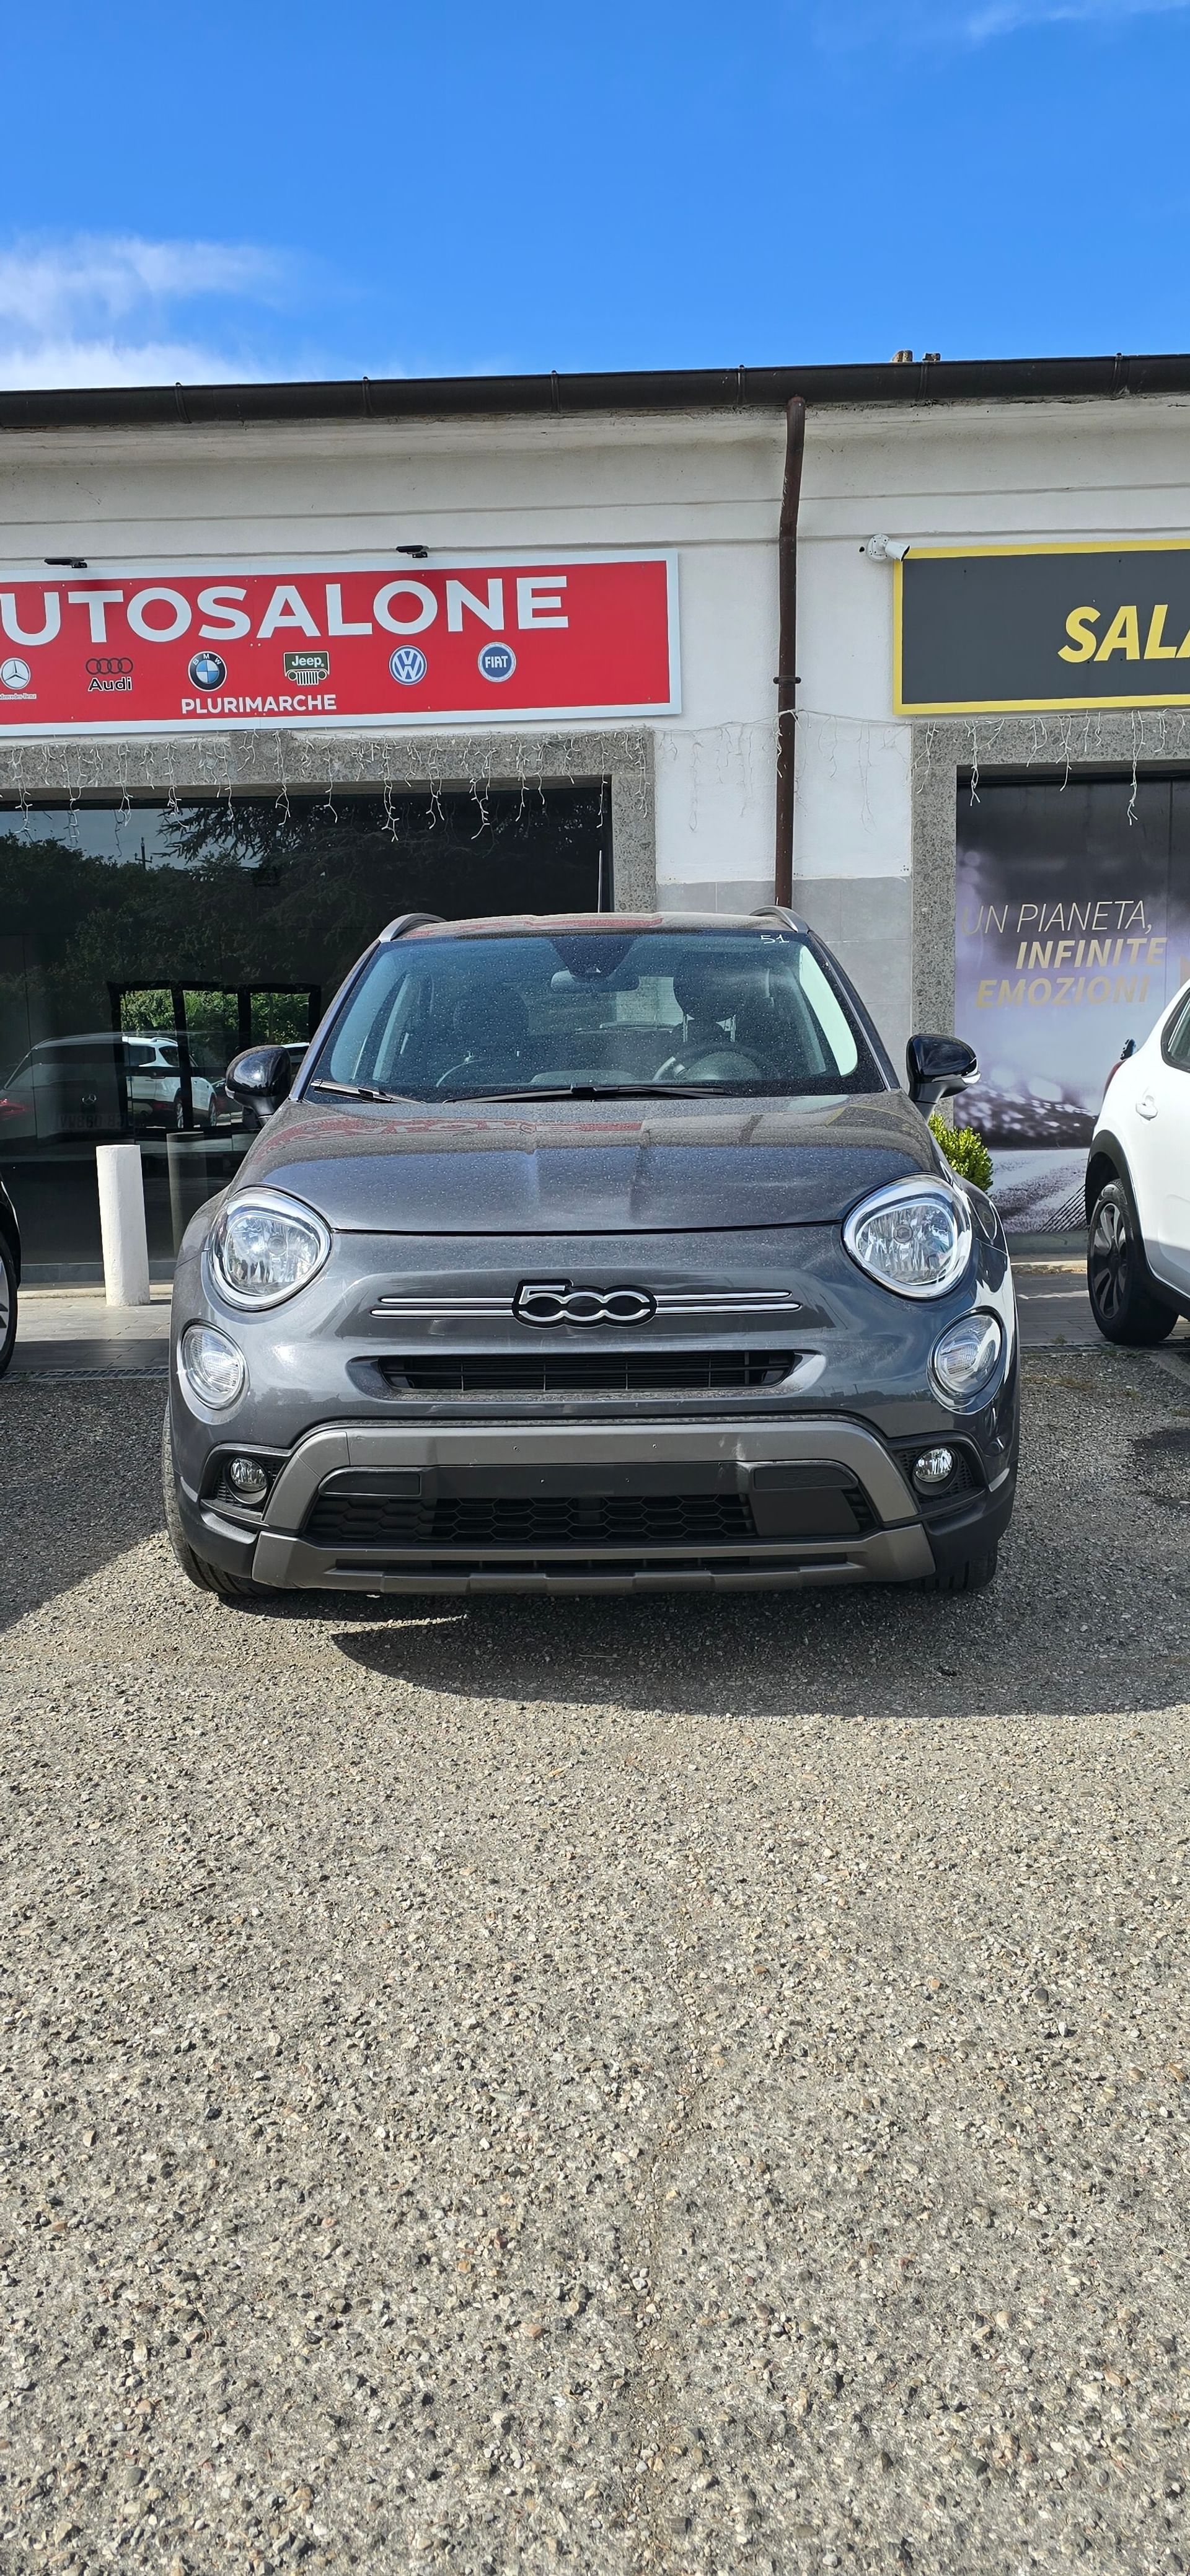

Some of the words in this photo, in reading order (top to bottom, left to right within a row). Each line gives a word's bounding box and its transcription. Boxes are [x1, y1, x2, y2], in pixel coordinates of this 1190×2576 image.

[192, 653, 221, 666] BMW
[485, 655, 508, 668] FIAT
[88, 676, 132, 691] Audi
[181, 694, 337, 714] PLURIMARCHE
[962, 904, 1008, 936] UN
[1016, 900, 1152, 935] PIANETA,
[760, 934, 790, 945] 51
[1015, 937, 1168, 969] INFINITE
[976, 975, 1150, 1009] EMOZIONI
[518, 1285, 651, 1321] 500
